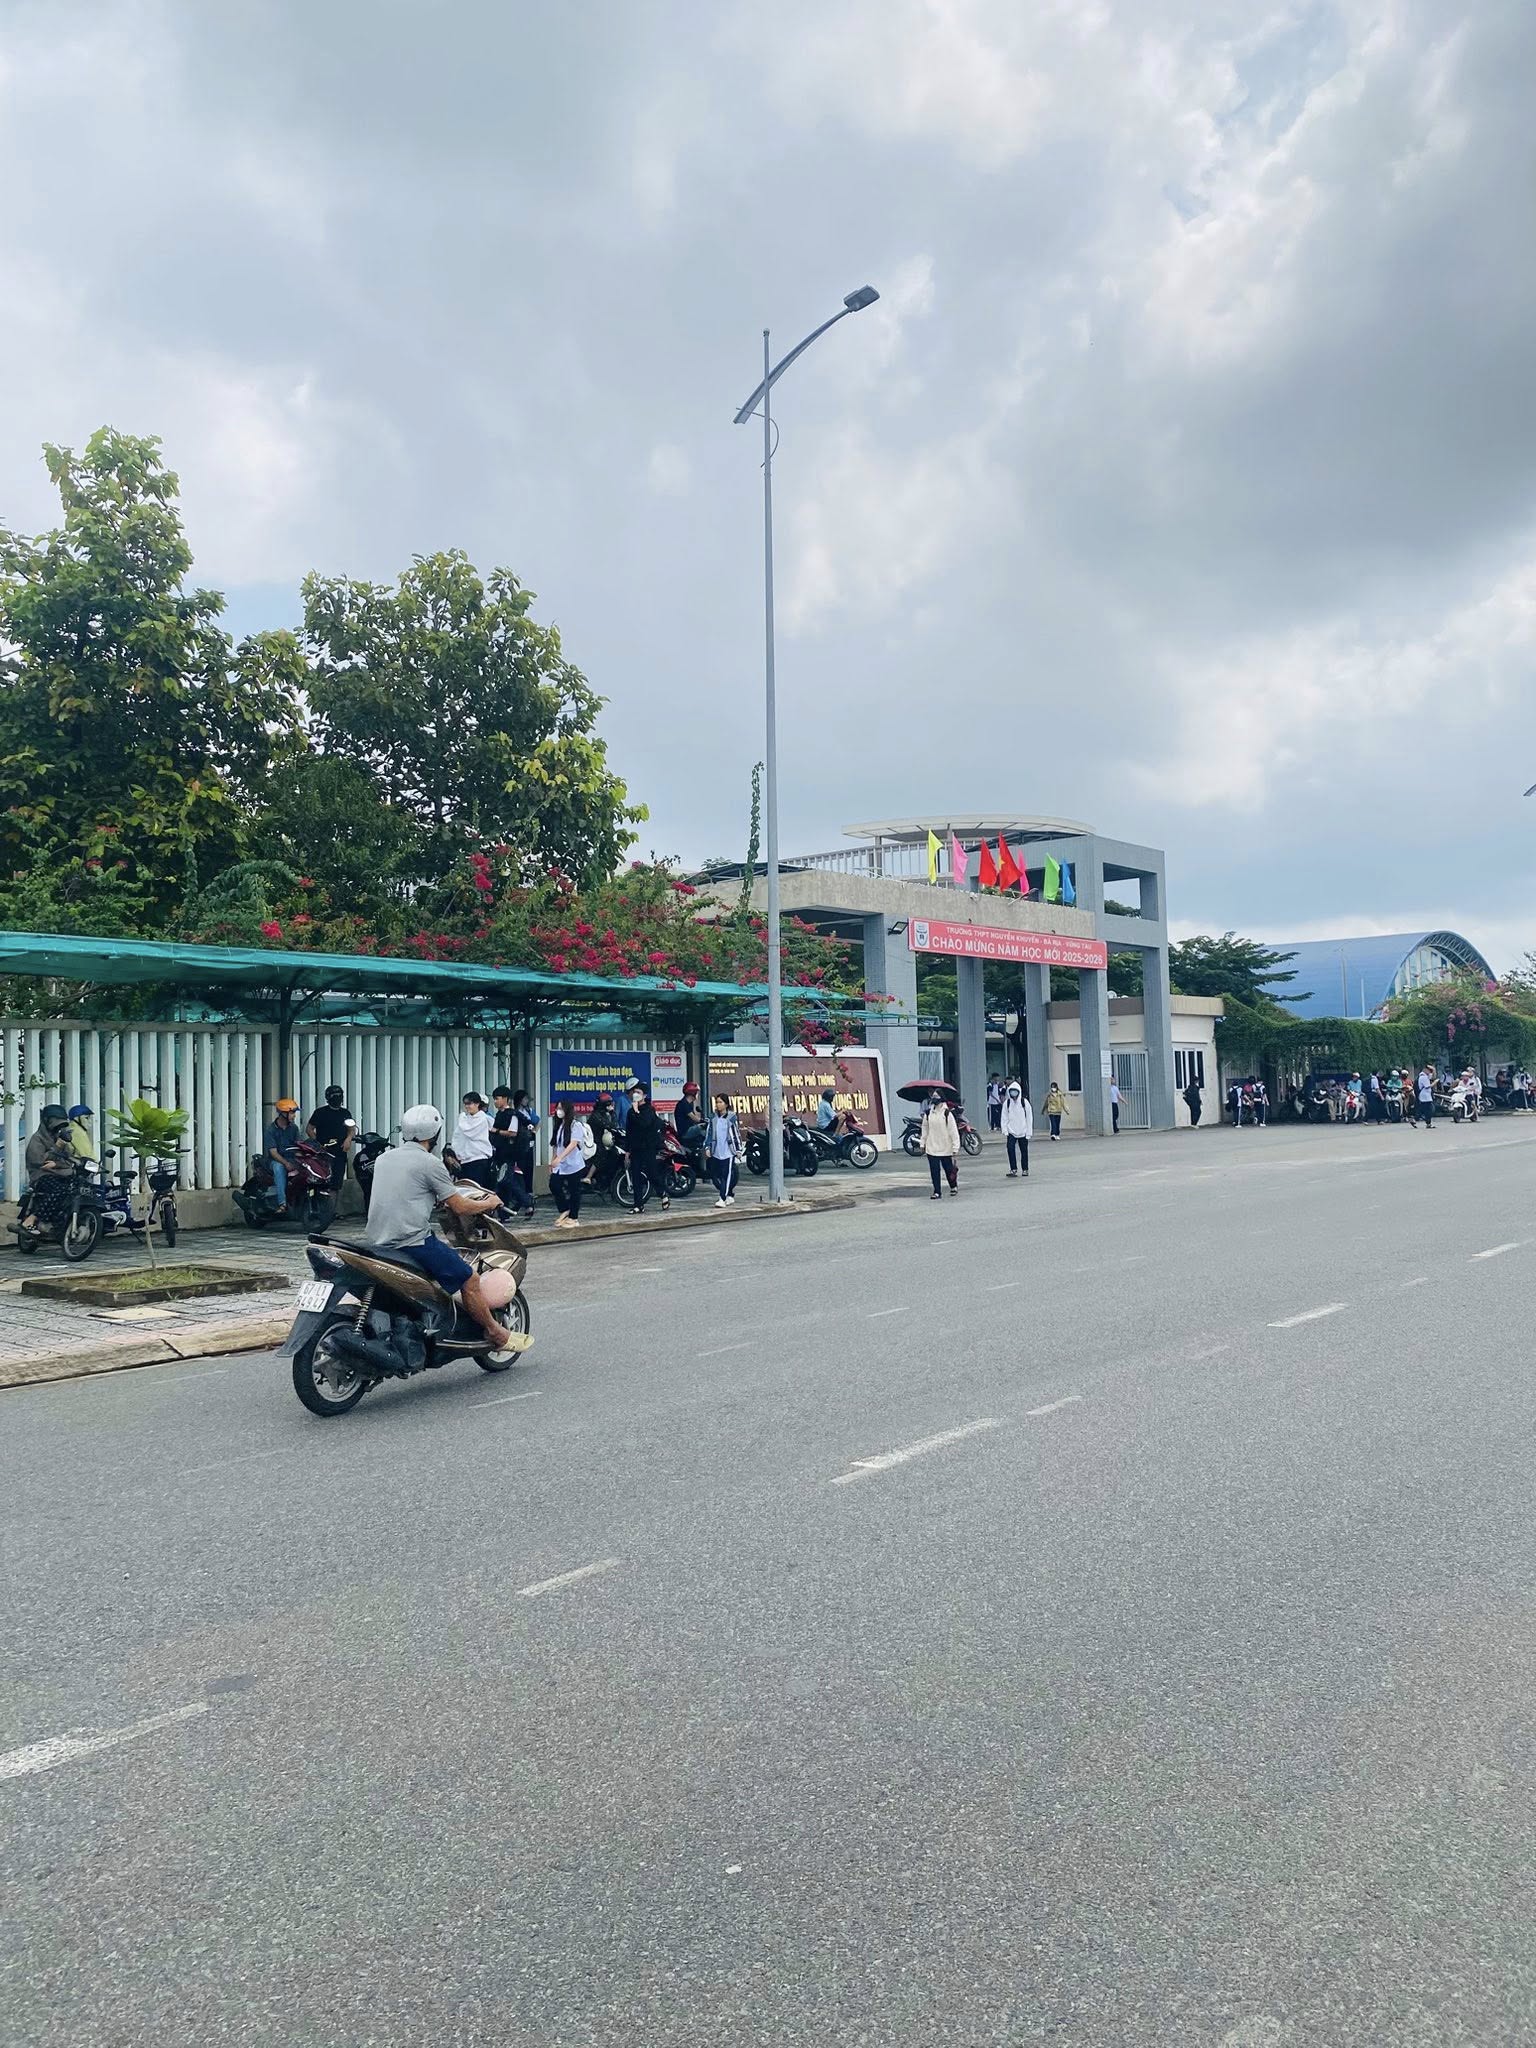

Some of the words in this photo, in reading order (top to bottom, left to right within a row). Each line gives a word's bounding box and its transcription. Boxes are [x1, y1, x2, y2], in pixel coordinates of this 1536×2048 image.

[974, 930, 989, 938] THPT
[932, 936, 962, 950] CHÀO
[965, 938, 995, 954] MỪNG
[998, 941, 1018, 956] NĂM
[1021, 946, 1041, 960] HỌC
[1044, 947, 1060, 961] MỚI
[1062, 951, 1103, 965] 2025-2026
[660, 1077, 685, 1085] HUTECH
[791, 1075, 804, 1089] HỌC
[794, 1091, 807, 1111] BÀ
[853, 1090, 869, 1110] TÀU
